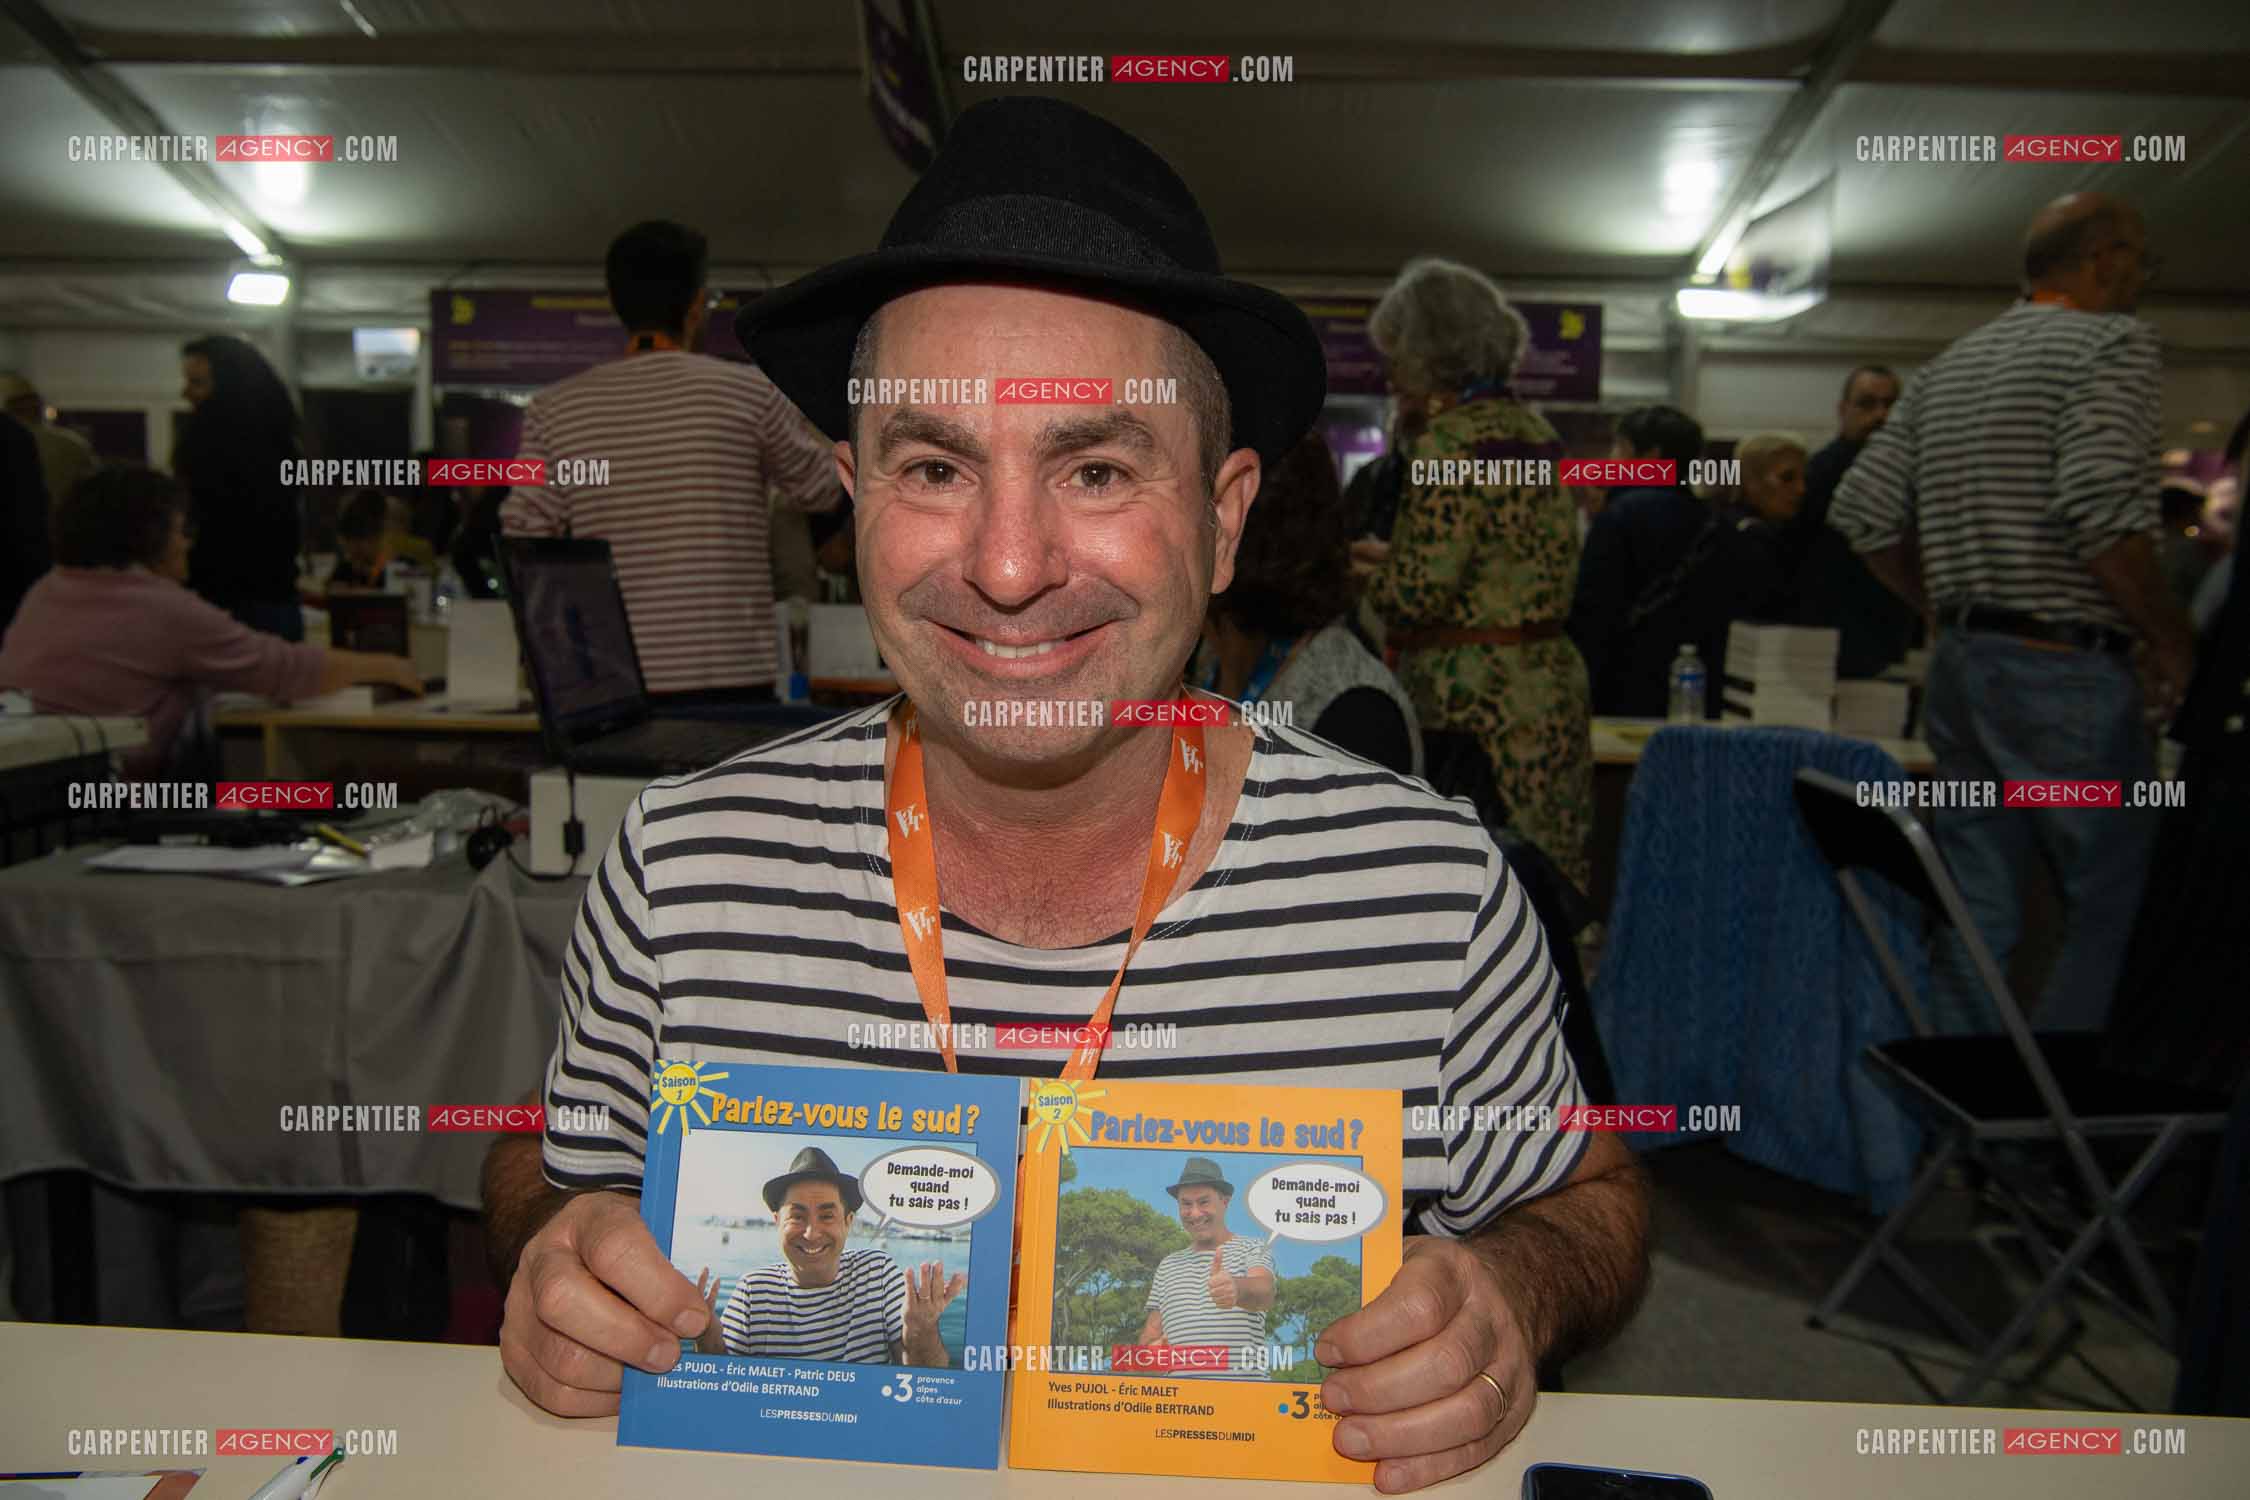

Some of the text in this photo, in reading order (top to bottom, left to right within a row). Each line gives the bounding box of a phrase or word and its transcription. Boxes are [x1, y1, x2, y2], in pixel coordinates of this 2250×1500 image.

[662, 1076, 696, 1088] Saison
[676, 1090, 682, 1101] 1
[1038, 1095, 1073, 1106] Saison
[712, 1093, 868, 1129] Parlez-vous
[878, 1102, 902, 1131] le
[1053, 1108, 1061, 1119] 2
[1090, 1111, 1249, 1145] Parlez-vous
[1260, 1117, 1285, 1147] le
[887, 1162, 974, 1178] Demande-moi
[910, 1181, 949, 1193] quand
[1271, 1177, 1360, 1193] Demande-moi
[889, 1194, 904, 1207] tu
[908, 1196, 934, 1208] sais
[938, 1197, 960, 1211] pas
[1295, 1195, 1336, 1208] quand
[1275, 1209, 1290, 1223] tu
[1295, 1211, 1321, 1224] sais
[1325, 1212, 1348, 1226] pas
[685, 1361, 718, 1374] PUJOL
[727, 1361, 746, 1376] Éric
[748, 1364, 784, 1378] MALET
[794, 1367, 825, 1381] Patric
[827, 1370, 856, 1383] DEUS
[657, 1376, 719, 1391] Illustrations
[761, 1383, 820, 1397] BERTRAND
[916, 1375, 955, 1385] provence
[916, 1384, 938, 1394] alpes
[1049, 1382, 1072, 1393] Yves
[1075, 1382, 1109, 1394] PUJOL
[1119, 1382, 1137, 1396] Éric
[1141, 1386, 1179, 1397] MALET
[1047, 1398, 1111, 1412] Illustrations
[1155, 1403, 1215, 1416] BERTRAND
